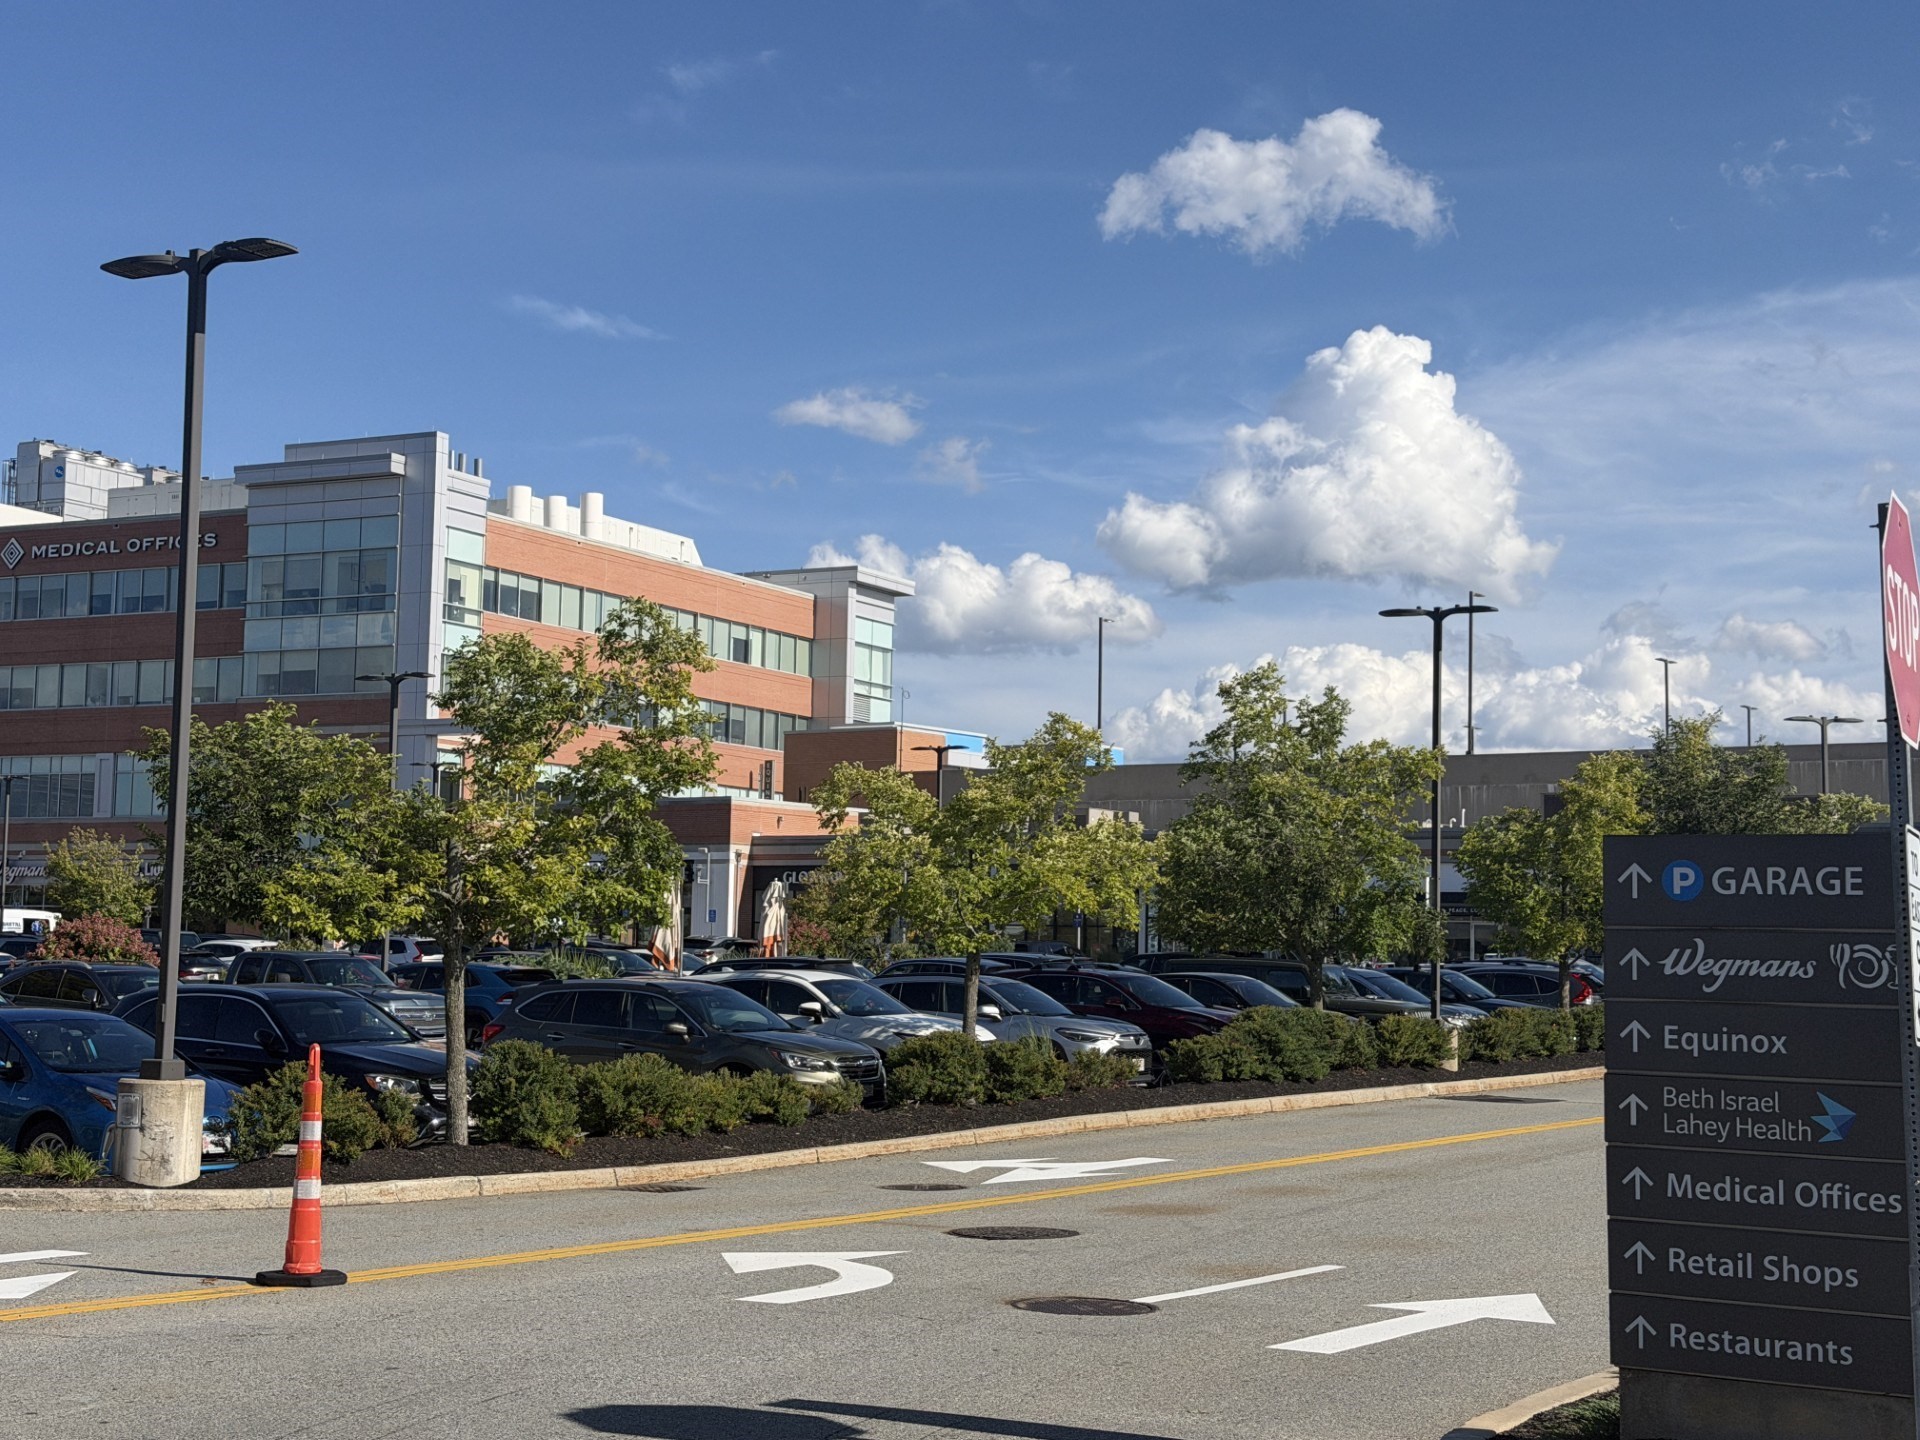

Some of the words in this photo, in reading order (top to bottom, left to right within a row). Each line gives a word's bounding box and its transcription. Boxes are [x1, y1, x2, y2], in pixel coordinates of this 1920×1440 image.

[31, 541, 121, 559] MEDICAL
[1887, 563, 1919, 673] STOP
[1672, 866, 1695, 894] P
[1711, 866, 1864, 896] GARAGE
[1657, 938, 1816, 992] Wegmans
[1663, 1025, 1787, 1057] Equinox
[1663, 1086, 1714, 1110] Beth
[1721, 1089, 1779, 1113] Israel
[1663, 1113, 1730, 1142] Lahey
[1735, 1117, 1812, 1142] Health
[1667, 1172, 1784, 1206] Medical
[1794, 1181, 1903, 1214] Offices
[1668, 1247, 1752, 1279] Retail
[1763, 1255, 1859, 1292] Shops
[1670, 1322, 1854, 1365] Restaurants
